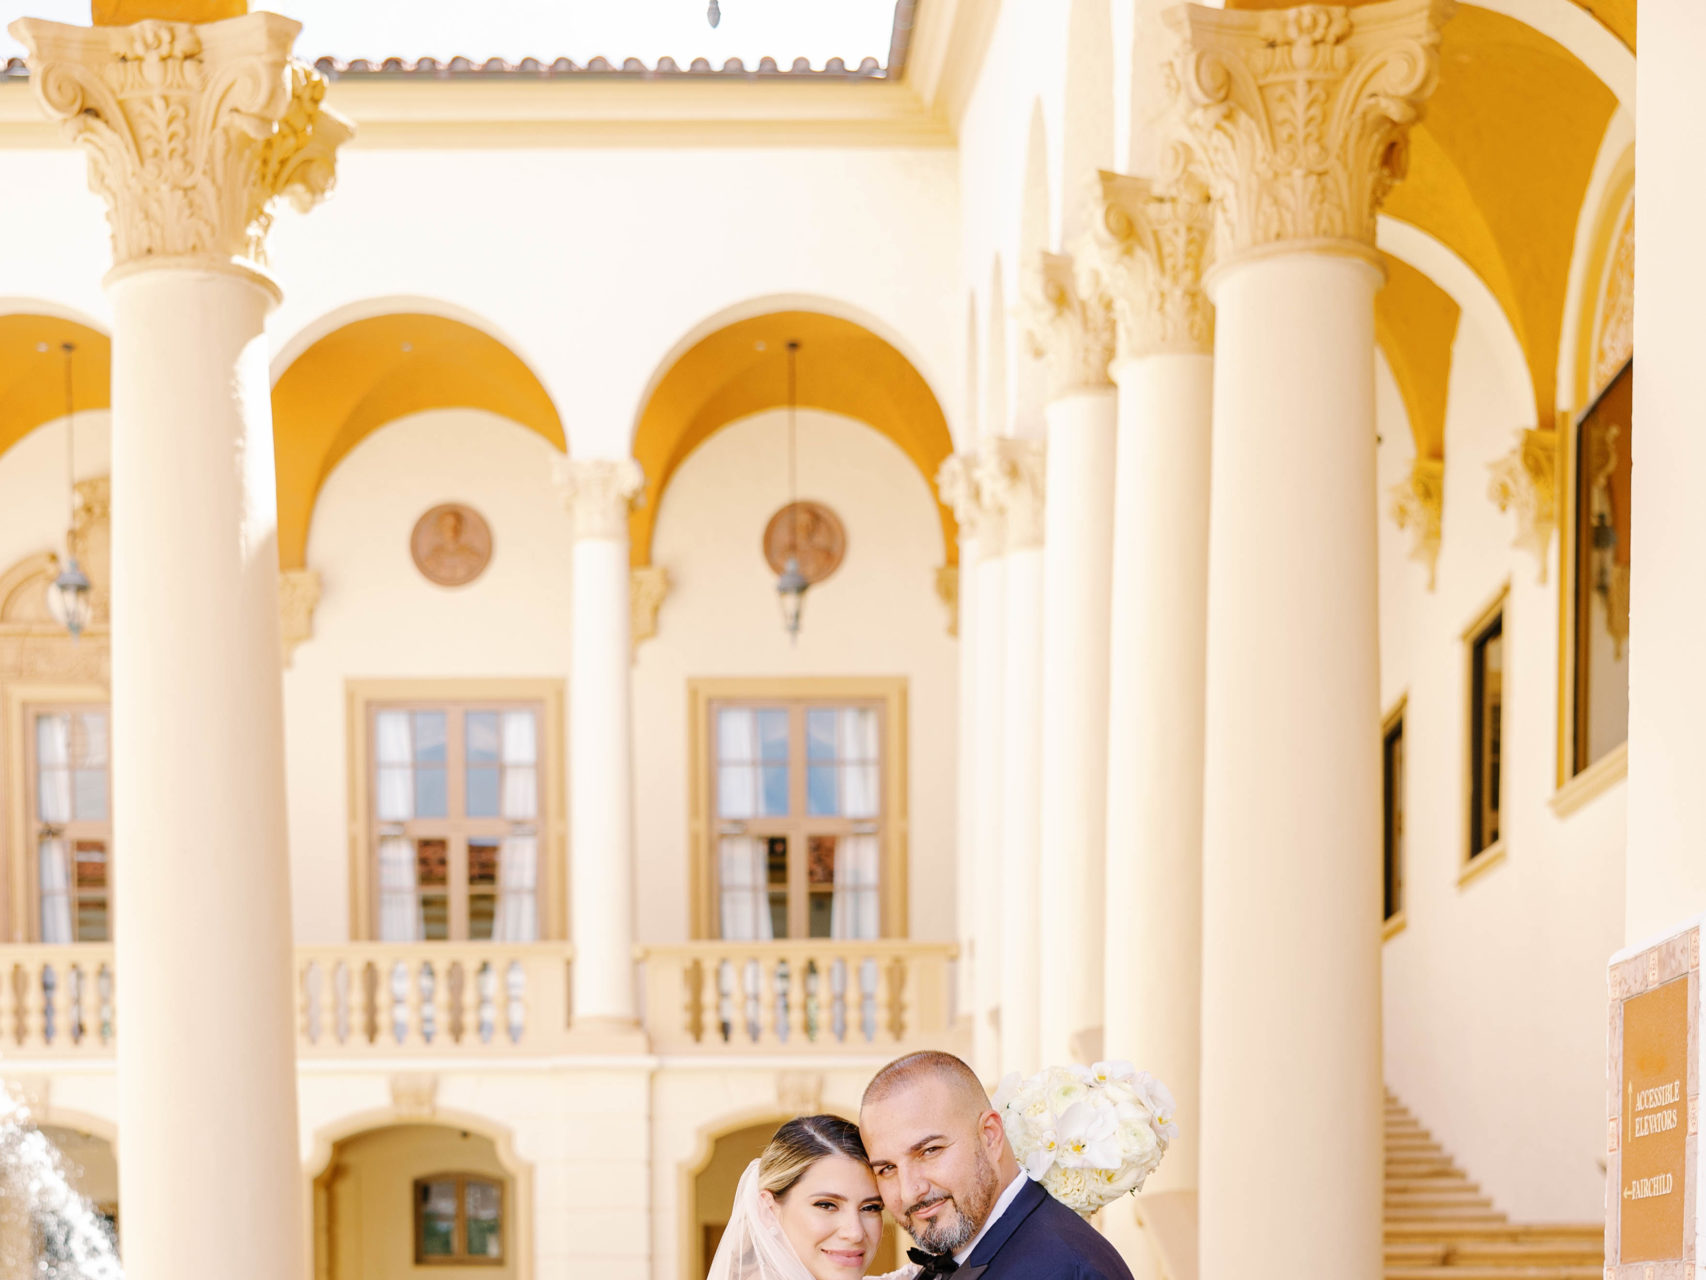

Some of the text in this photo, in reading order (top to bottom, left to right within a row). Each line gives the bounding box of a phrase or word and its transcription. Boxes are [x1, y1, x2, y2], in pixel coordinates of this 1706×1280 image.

[1635, 1080, 1680, 1111] ACCESSIBLE
[1635, 1109, 1677, 1138] ELEVATORS
[1632, 1173, 1673, 1200] FAIRCHILD
